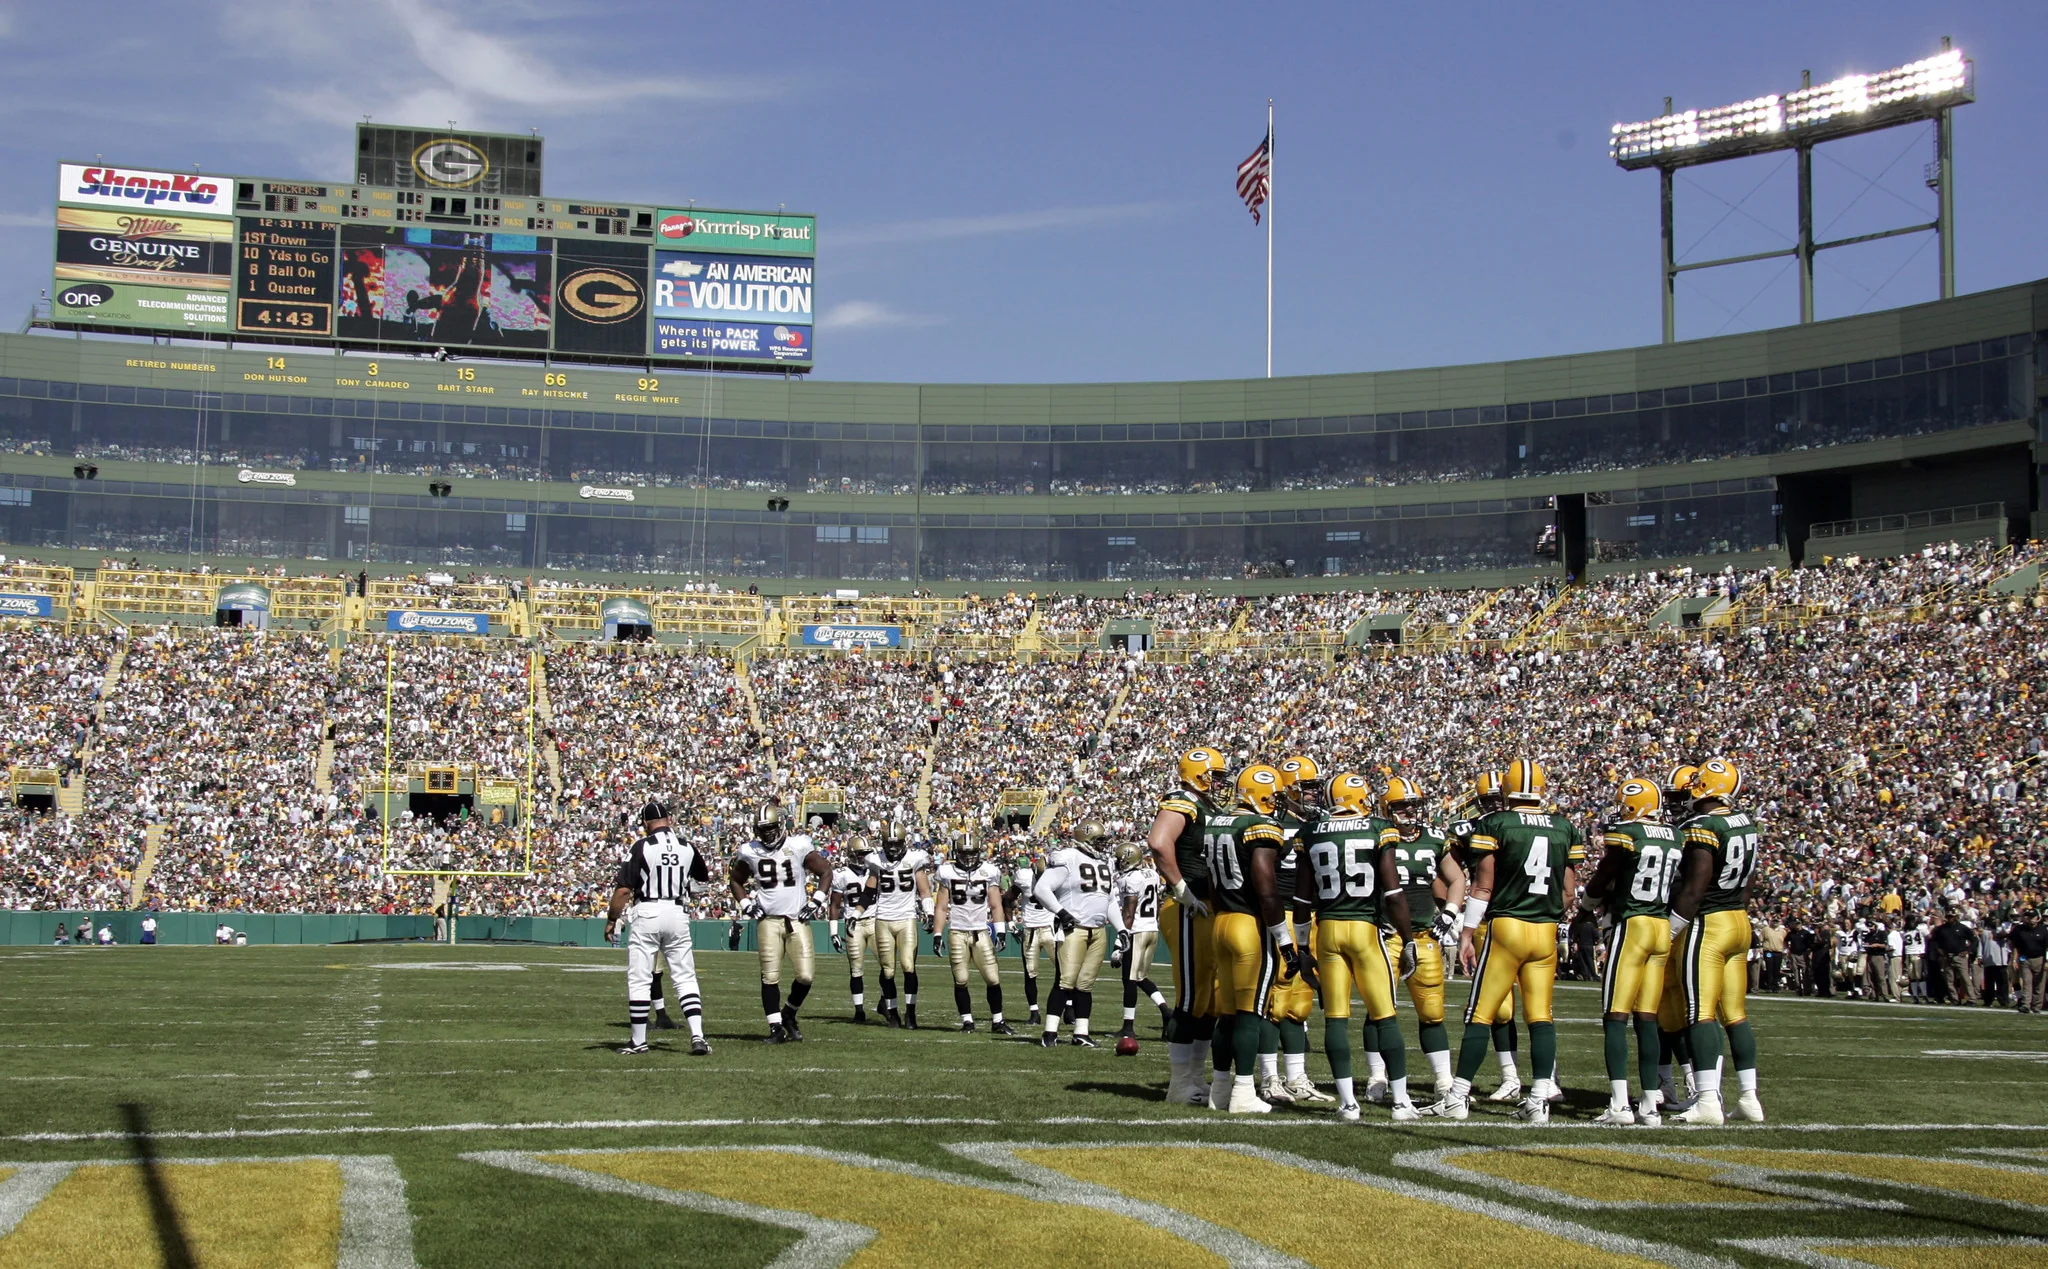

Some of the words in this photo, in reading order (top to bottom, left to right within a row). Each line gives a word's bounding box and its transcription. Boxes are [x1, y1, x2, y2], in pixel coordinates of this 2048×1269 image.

[270, 184, 320, 196] PACKERS
[372, 191, 393, 200] RUSH
[319, 204, 338, 214] TOTAL
[504, 200, 525, 209] RUSH
[580, 205, 618, 216] SAINTS
[372, 208, 393, 218] PASS
[117, 216, 183, 236] Miller
[503, 217, 524, 227] PASS
[556, 220, 574, 230] TOTAL
[764, 224, 811, 240] Kraut
[244, 232, 267, 245] 1ST
[271, 233, 306, 247] Down
[90, 237, 200, 259] GENUINE
[112, 252, 179, 271] Draft
[243, 247, 259, 259] 10
[268, 249, 292, 262] Yds
[295, 251, 307, 263] to
[311, 252, 329, 264] Go
[249, 264, 259, 276] 8
[268, 265, 296, 277] Ball
[297, 266, 316, 278] On
[706, 263, 729, 281] AN
[733, 264, 812, 284] AMERICAN
[249, 279, 256, 292] 1
[268, 281, 316, 295] Quarter
[65, 292, 101, 307] one
[186, 293, 227, 304] ADVANCED
[655, 279, 812, 314] REVOLUTION
[137, 299, 227, 313] TELECOMMUNICATIONS
[183, 312, 227, 323] SOLUTIONS
[257, 309, 315, 327] 4:43
[659, 325, 698, 337] Where
[702, 327, 722, 338] the
[726, 328, 759, 340] PACK
[661, 339, 687, 349] gets
[692, 338, 708, 349] its
[712, 338, 760, 351] POWER.
[126, 359, 167, 369] RETIRED
[170, 362, 217, 372] NUMBERS
[267, 357, 286, 370] 14
[367, 362, 378, 376] 3
[244, 373, 265, 382] DON
[268, 374, 307, 384] HUTSON
[457, 367, 475, 381] 15
[544, 373, 567, 387] 66
[335, 378, 361, 387] TONY
[365, 379, 409, 389] CANADEO
[437, 384, 461, 393] BART
[465, 385, 495, 394] STARR
[637, 378, 659, 392] 92
[521, 388, 539, 397] RAY
[543, 389, 588, 400] NITSCHKE
[615, 393, 648, 403] REGGIE
[652, 395, 680, 404] WHITE
[2, 599, 37, 608] ZONE
[420, 616, 442, 625] END
[442, 617, 475, 626] ZONE
[834, 630, 856, 639] END
[856, 630, 887, 639] ZONE
[1312, 818, 1370, 834] JENNINGS
[1518, 812, 1553, 828] FAVRE
[1643, 824, 1675, 841] DRIVER
[661, 853, 680, 866] 53
[1524, 836, 1551, 895] 4
[1717, 832, 1758, 890] 87
[758, 858, 796, 889] 91
[1309, 838, 1375, 900] 85
[1630, 845, 1682, 904] 80
[879, 868, 915, 893] 55
[1079, 863, 1112, 894] 99
[950, 878, 988, 906] 53
[1140, 884, 1158, 918] 2
